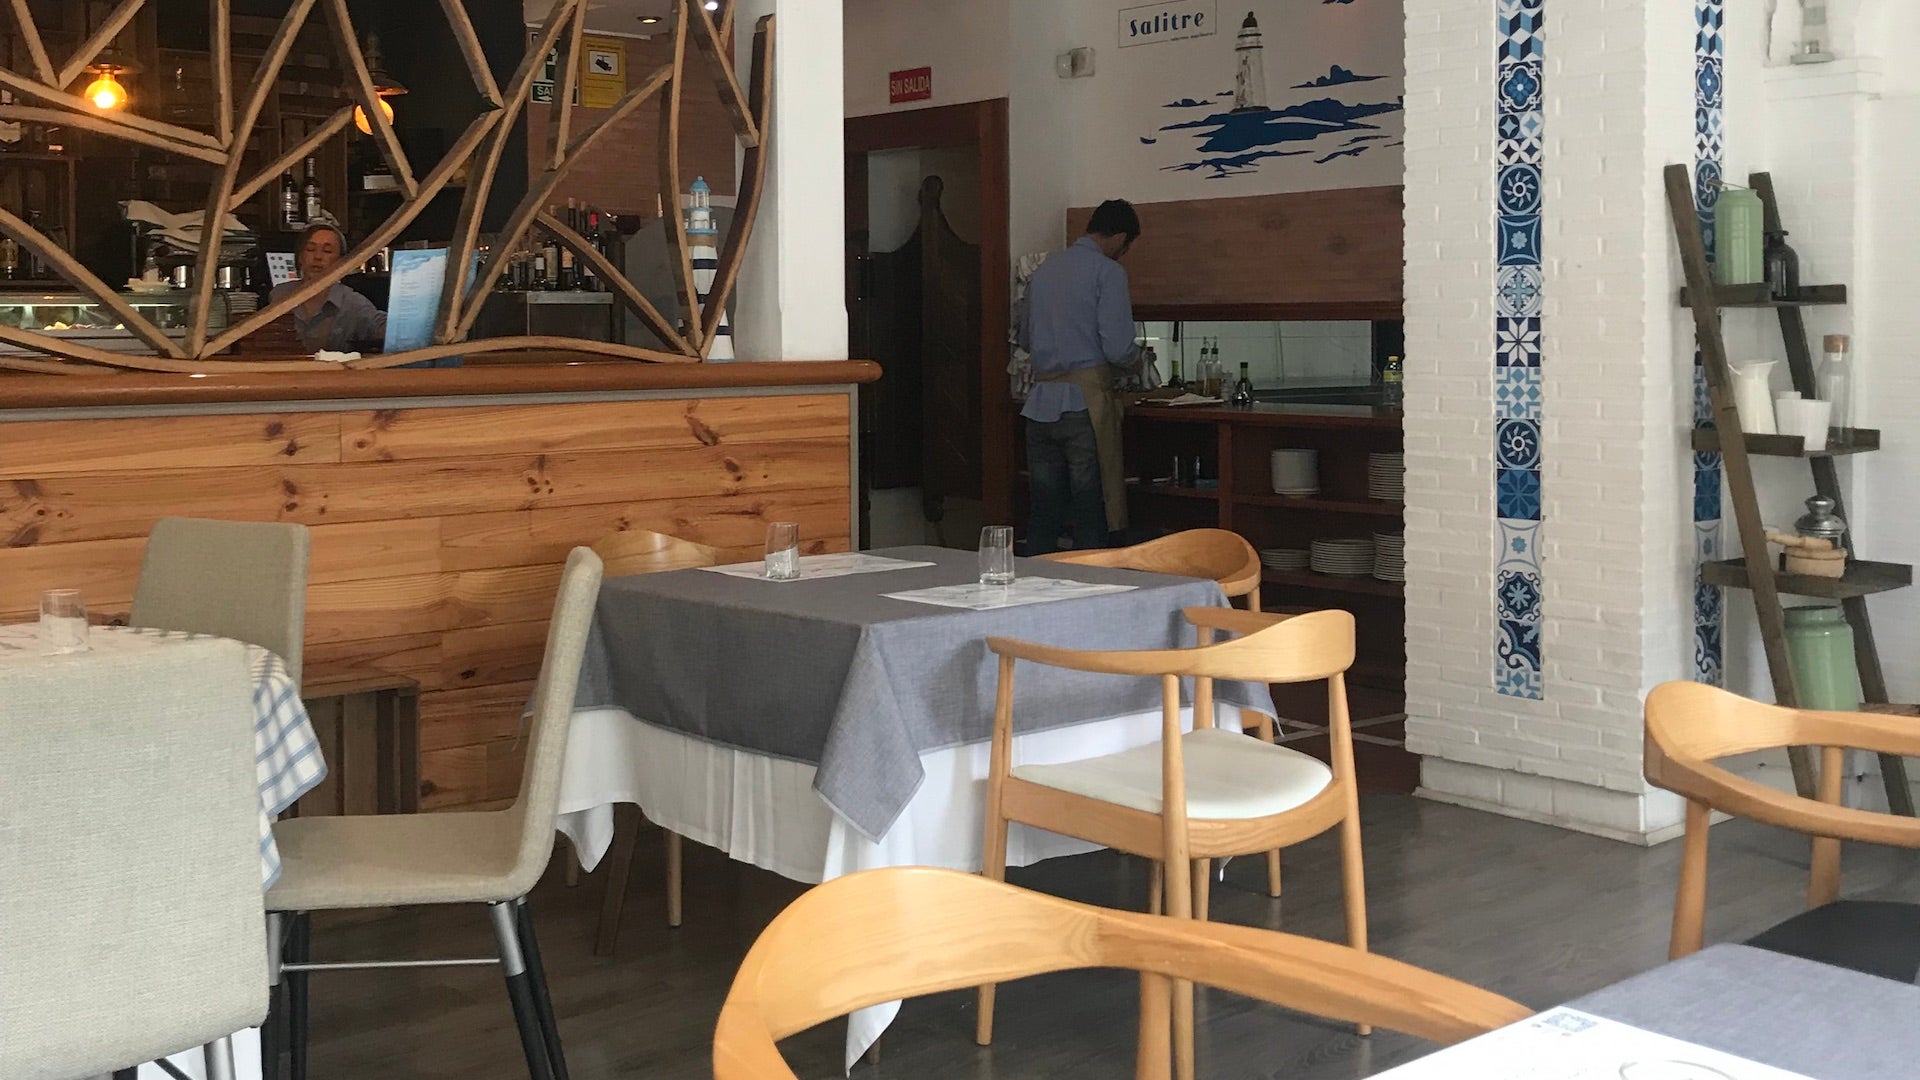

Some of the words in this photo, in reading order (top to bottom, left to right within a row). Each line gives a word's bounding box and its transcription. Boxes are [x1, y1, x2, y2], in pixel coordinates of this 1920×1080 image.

[1130, 12, 1204, 37] Salitre
[891, 79, 903, 96] SIN
[904, 76, 930, 94] SALIDA
